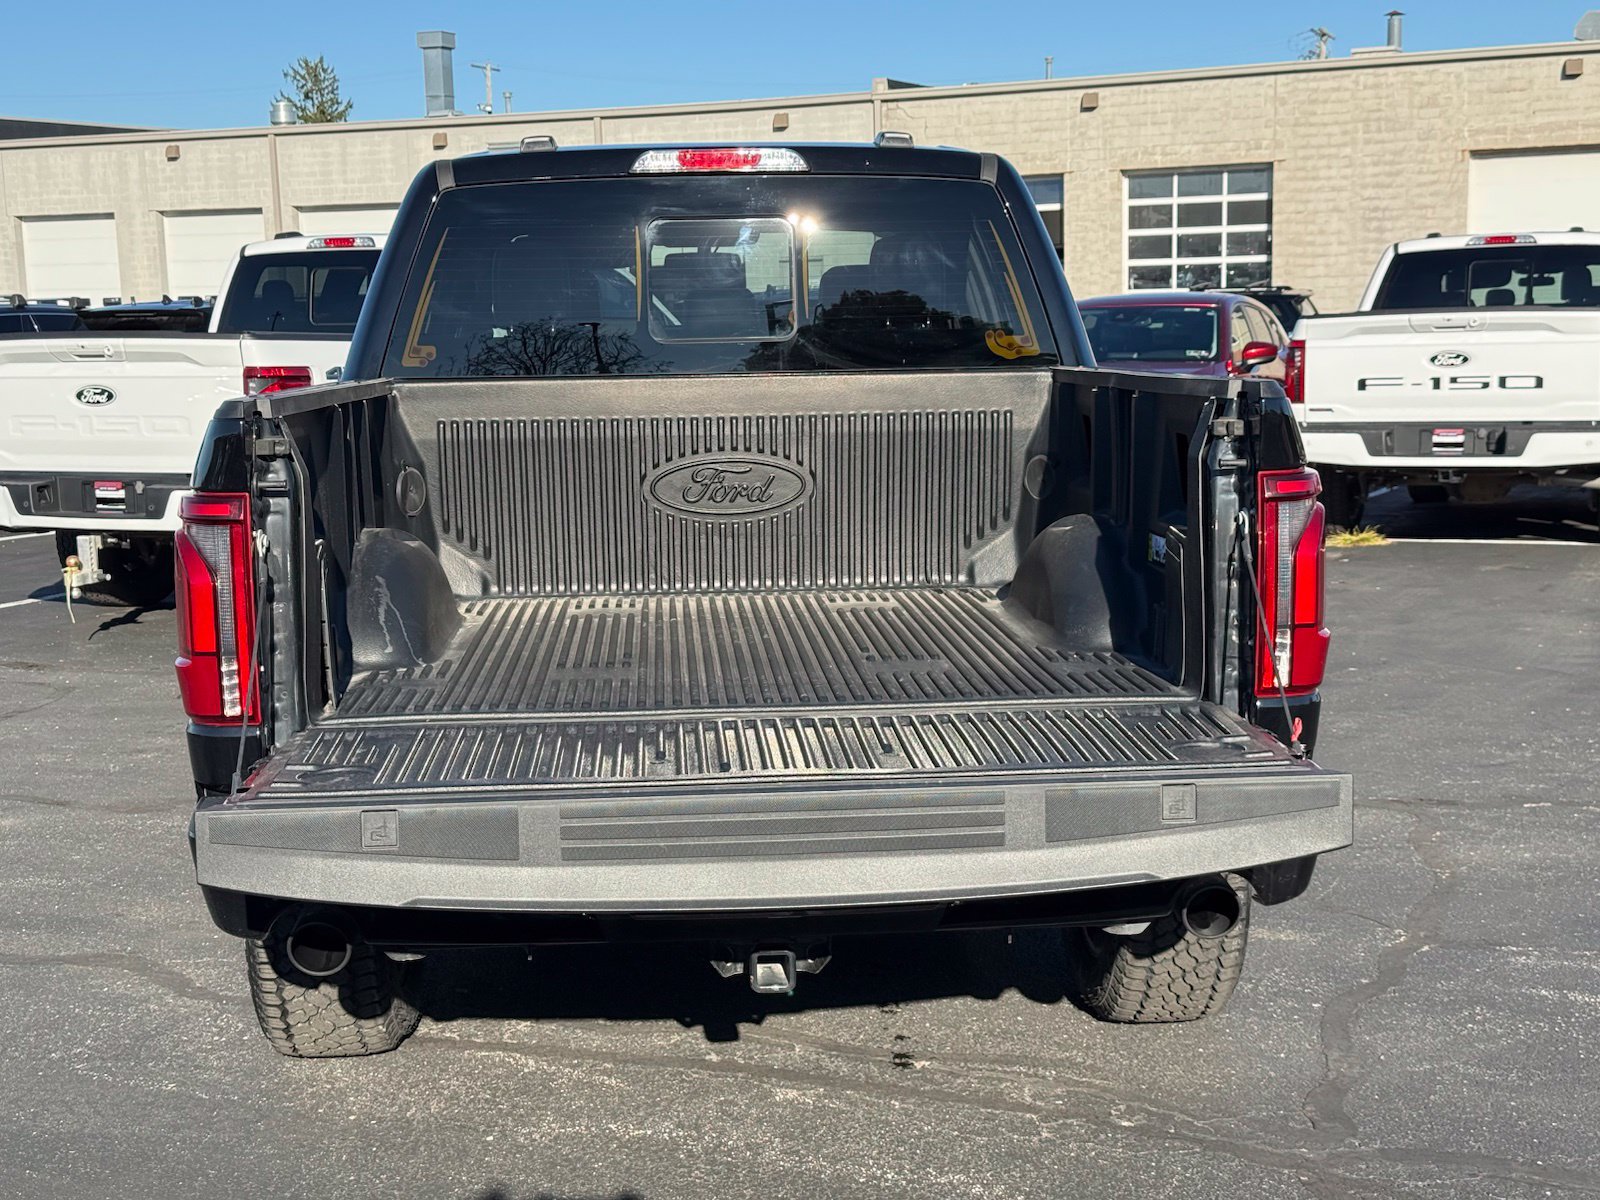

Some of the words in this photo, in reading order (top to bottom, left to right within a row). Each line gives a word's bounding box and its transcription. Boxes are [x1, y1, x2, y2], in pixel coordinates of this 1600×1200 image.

[1434, 353, 1465, 367] Ford
[1357, 375, 1544, 392] F-150
[80, 388, 109, 404] Ford
[9, 414, 192, 437] F-150
[682, 464, 776, 504] Ford
